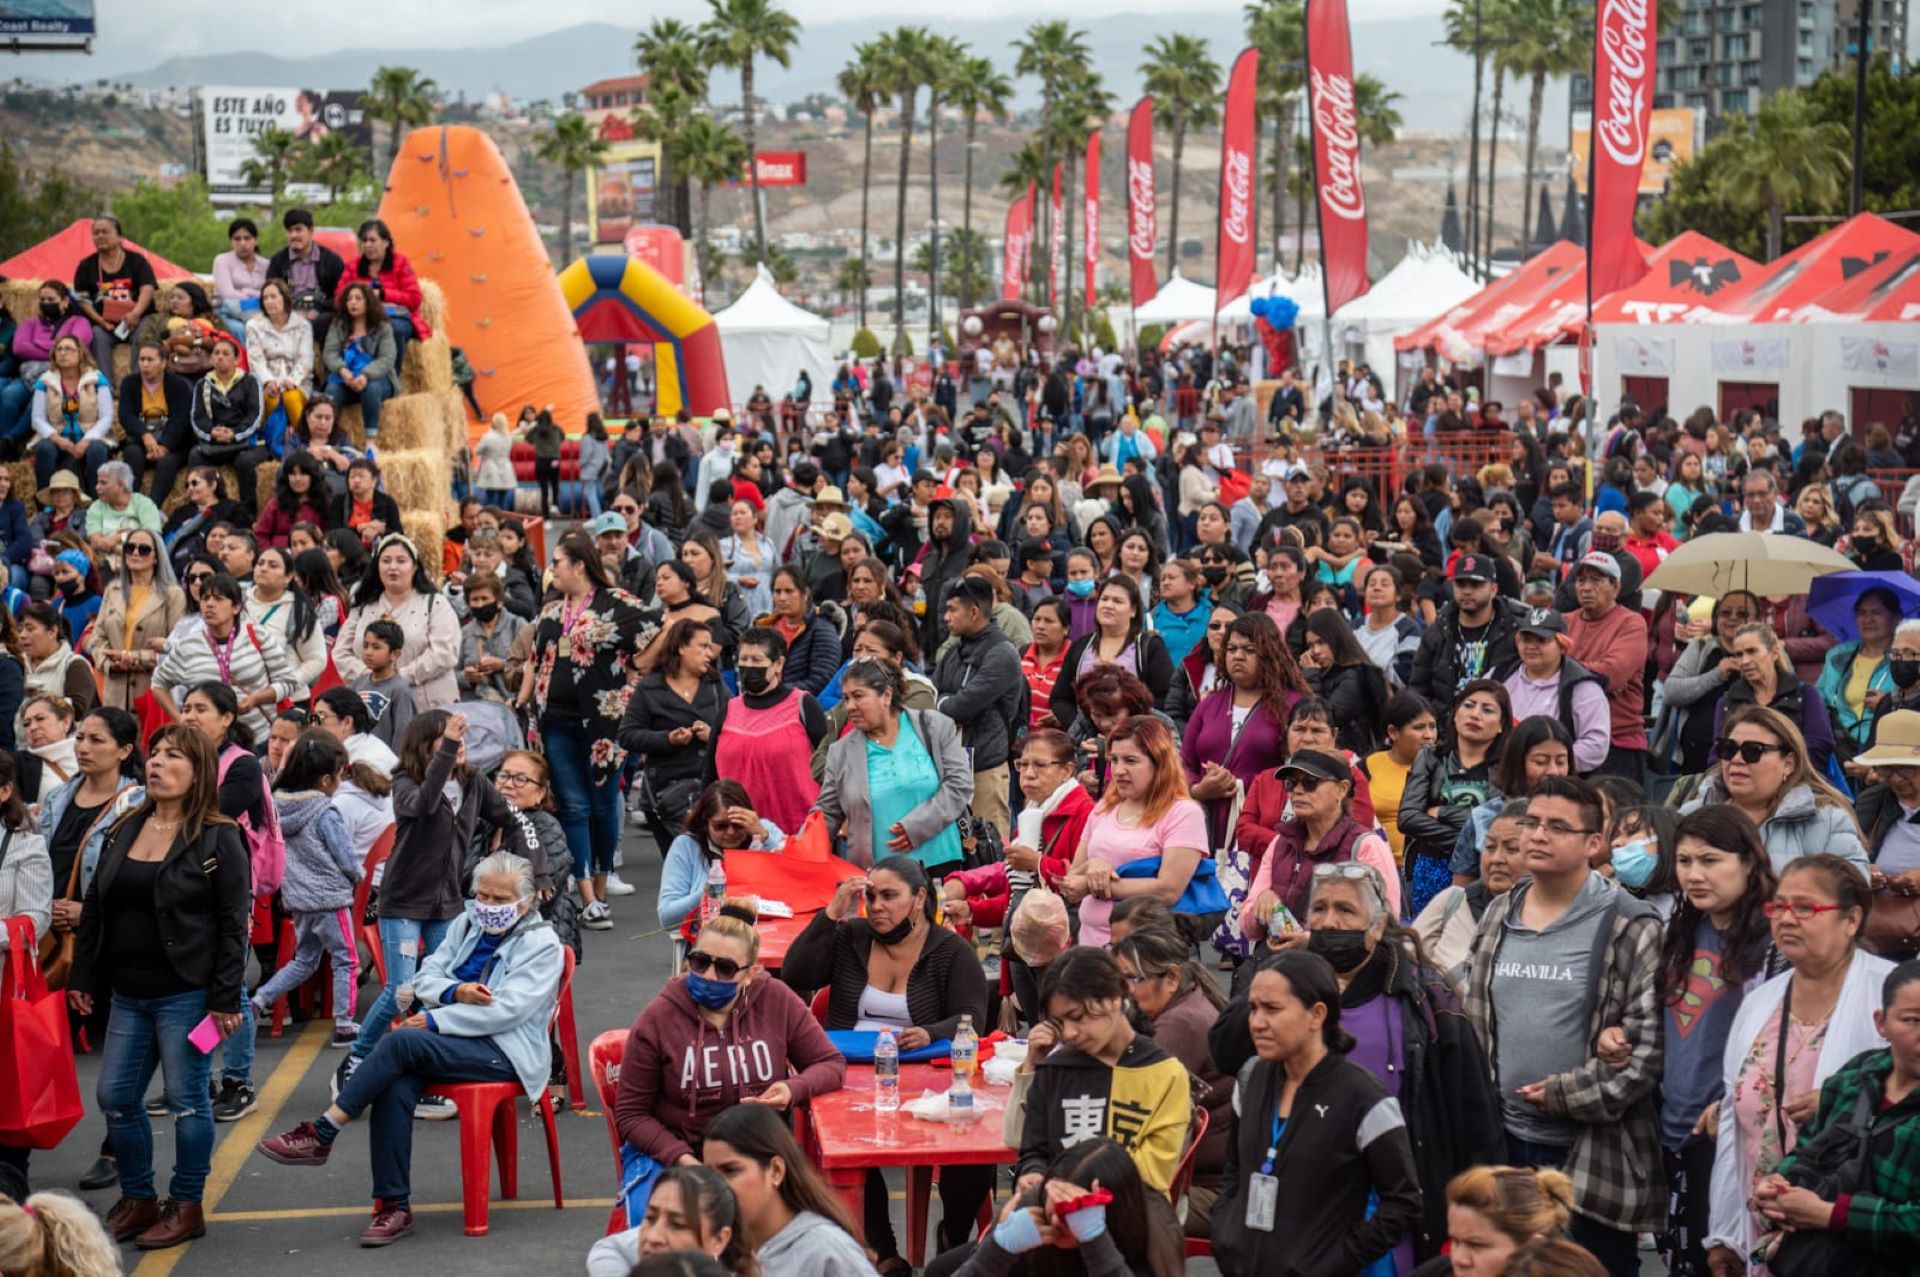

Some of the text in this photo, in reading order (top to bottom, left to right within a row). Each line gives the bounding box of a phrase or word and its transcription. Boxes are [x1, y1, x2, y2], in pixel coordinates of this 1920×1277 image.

[213, 94, 286, 114] ESTE AÑO
[214, 117, 277, 135] ES TUYO
[1311, 66, 1365, 220] Coca-Cola
[1129, 157, 1155, 260] Coca-Cola
[1225, 146, 1250, 244] Coca-Cola
[680, 1040, 773, 1089] AERO
